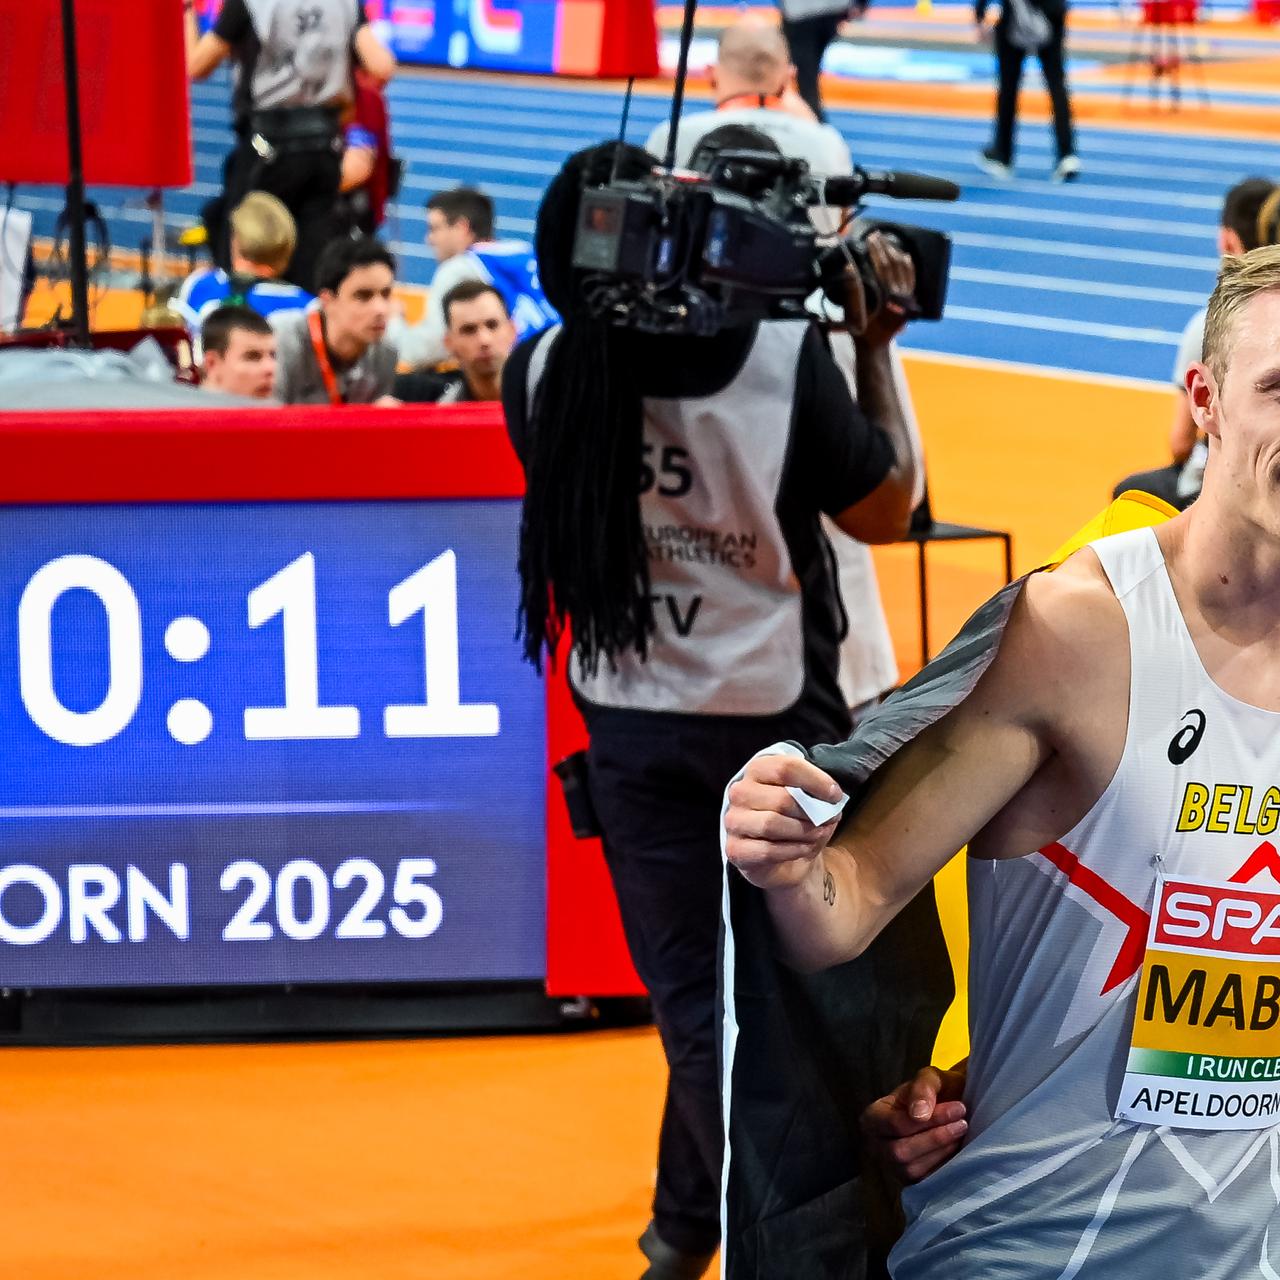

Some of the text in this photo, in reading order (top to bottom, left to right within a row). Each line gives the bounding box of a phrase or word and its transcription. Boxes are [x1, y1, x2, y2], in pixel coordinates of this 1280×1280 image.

[644, 526, 757, 552] UROPEAN
[18, 548, 501, 747] 0:11
[219, 857, 443, 942] 2025
[1187, 1055, 1195, 1076] I
[1199, 1056, 1247, 1079] RUN
[1130, 1086, 1280, 1118] APELDOORN
